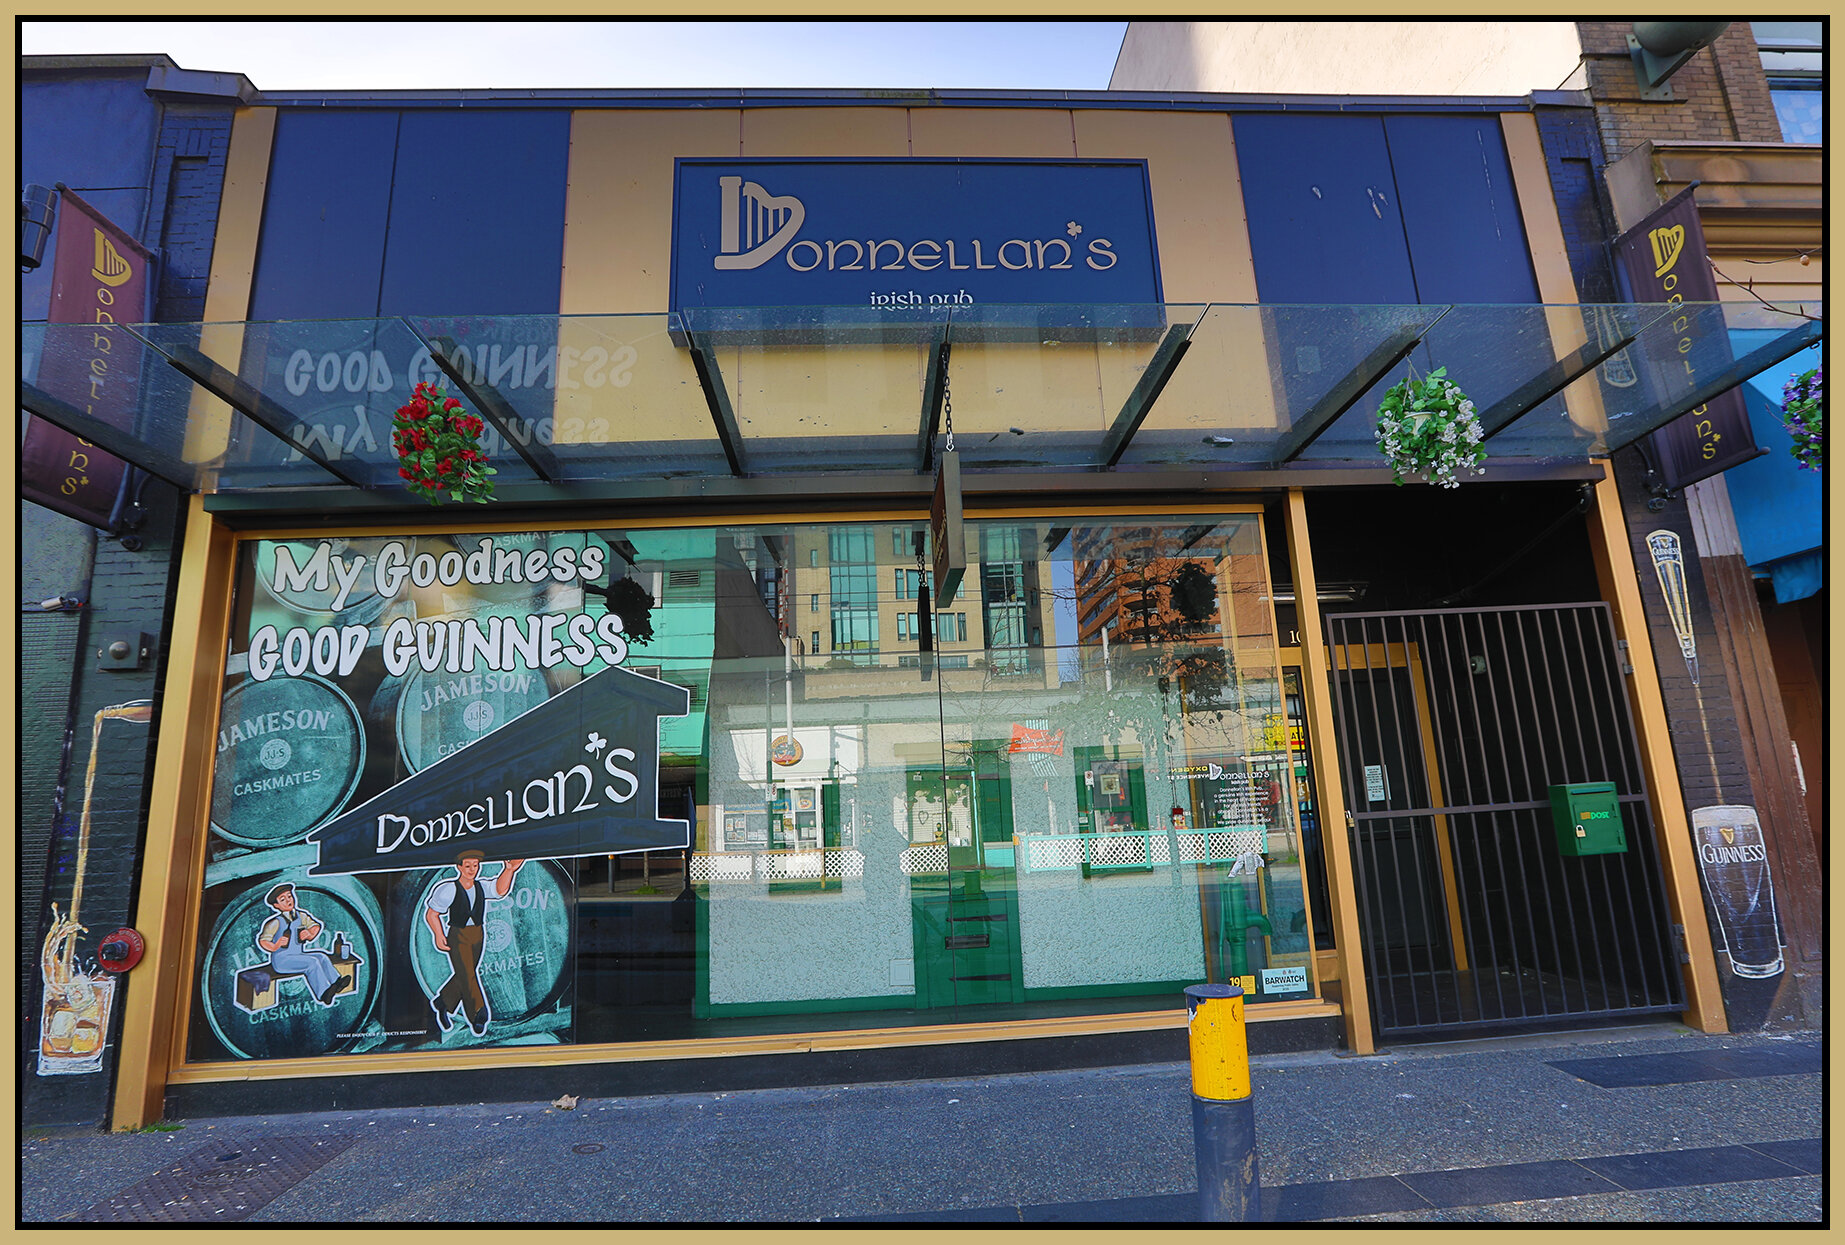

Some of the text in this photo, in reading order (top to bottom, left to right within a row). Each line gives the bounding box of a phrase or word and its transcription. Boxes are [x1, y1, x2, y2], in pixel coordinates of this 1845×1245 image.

[870, 289, 974, 313] irish pub
[273, 538, 605, 612] My Goodness
[248, 613, 628, 682] GOOD GUINNESS
[420, 674, 532, 711] JAMESON
[218, 709, 331, 752] JAMESON
[233, 769, 322, 797] CASKMATES
[376, 731, 639, 854] Donnellan's
[1702, 843, 1764, 864] GUINNESS
[479, 951, 545, 976] SKMATES
[1264, 975, 1305, 985] BARWATCH
